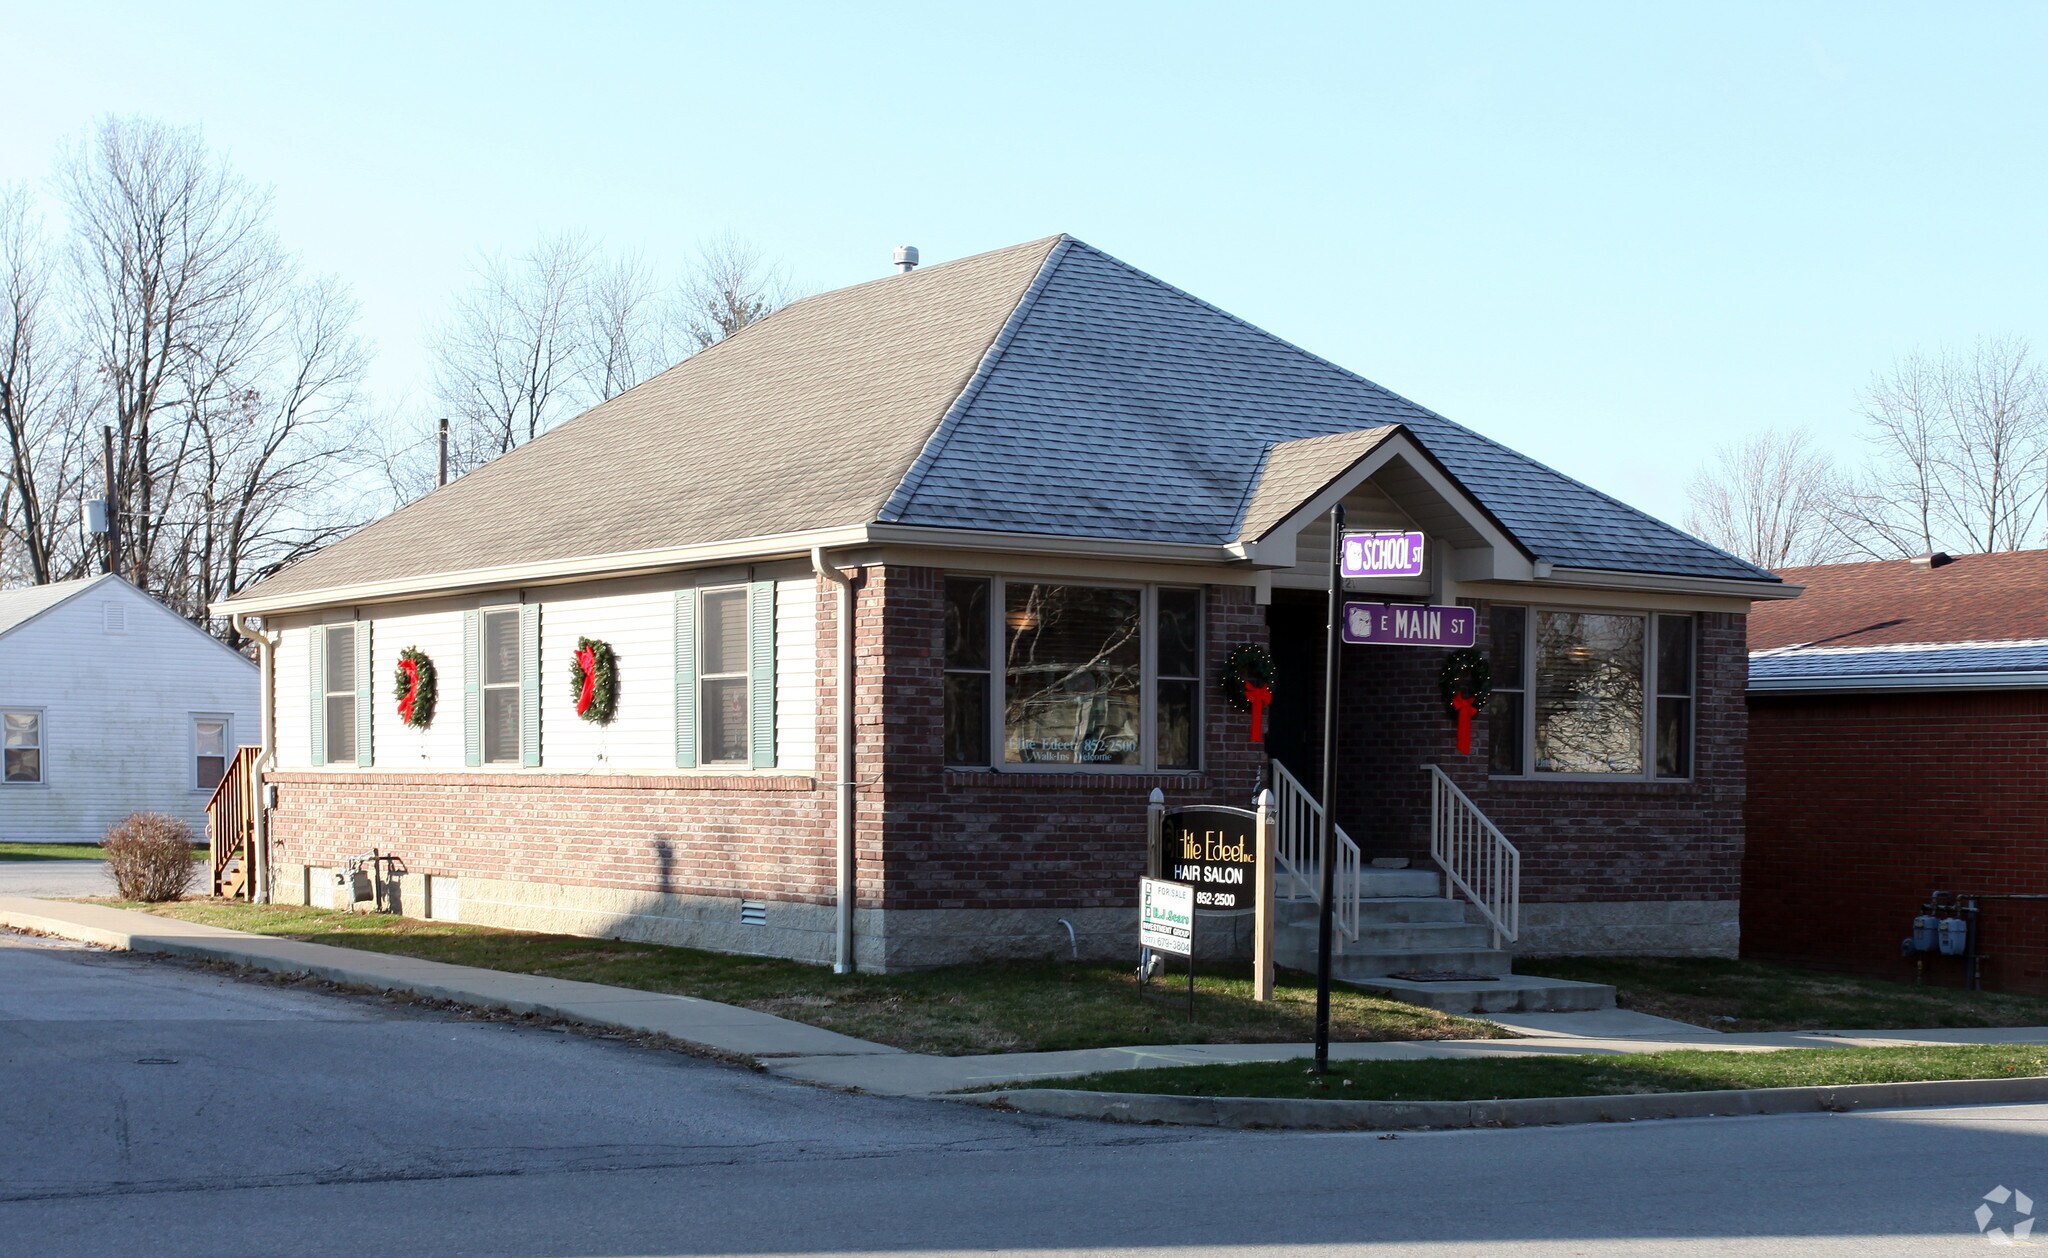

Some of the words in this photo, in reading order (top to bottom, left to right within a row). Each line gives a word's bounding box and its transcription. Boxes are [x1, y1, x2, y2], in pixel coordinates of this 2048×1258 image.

[1363, 537, 1412, 570] SCHOOL
[1412, 546, 1422, 563] ST
[1381, 615, 1388, 631] E
[1395, 609, 1441, 640] MAIN
[1451, 618, 1465, 634] ST
[1083, 740, 1137, 753] 852-2500
[1032, 751, 1070, 761] Walk-Ins
[1205, 830, 1244, 863] Edeet
[1174, 864, 1201, 882] HAIR
[1203, 865, 1243, 885] SALON
[1158, 886, 1170, 897] FOR
[1171, 889, 1187, 900] SALE
[1196, 891, 1235, 907] 852-2500
[1143, 921, 1172, 935] INVESTMENT
[1172, 927, 1190, 938] GROUP
[1157, 936, 1190, 953] 679-3804
